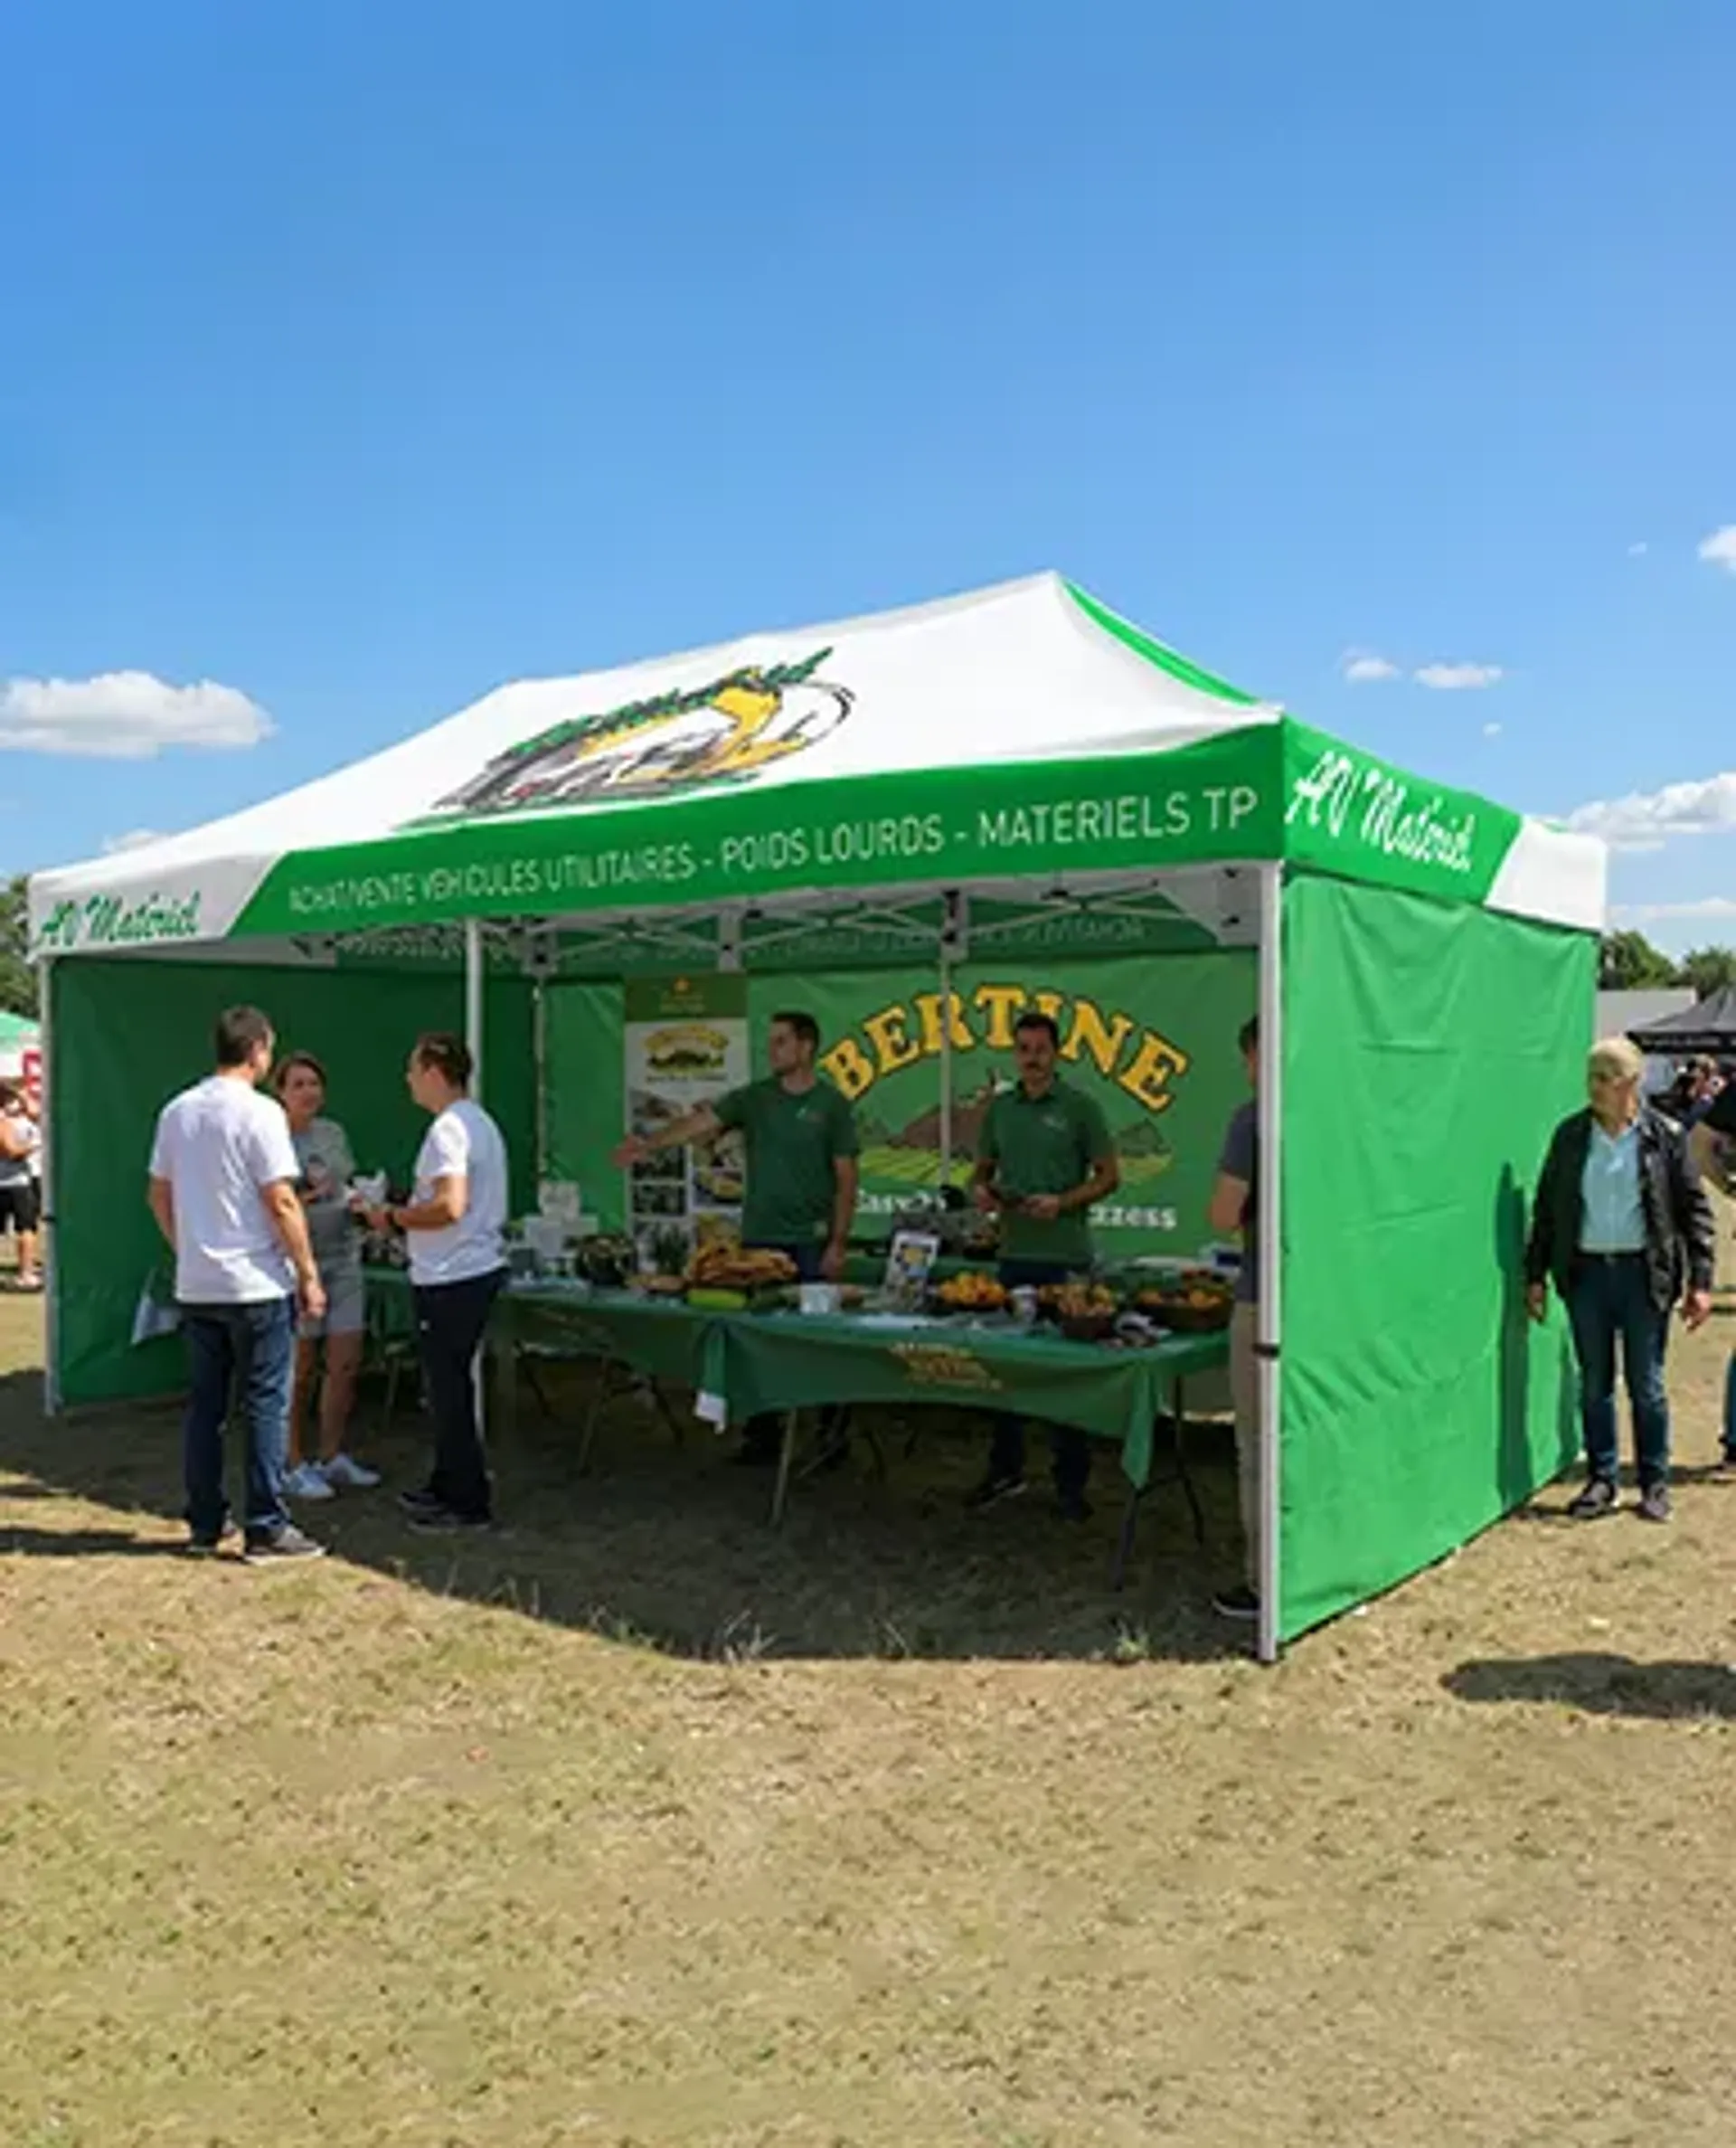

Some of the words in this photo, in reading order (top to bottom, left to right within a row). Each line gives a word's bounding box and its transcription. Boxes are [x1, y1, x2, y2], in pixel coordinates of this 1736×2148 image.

[546, 843, 697, 892] UTILITAIRES
[722, 827, 810, 875] POIDS
[816, 812, 946, 866] LOURDS
[977, 790, 1192, 849] MATERIELS
[1202, 785, 1259, 830] TP
[1284, 750, 1361, 838] AV
